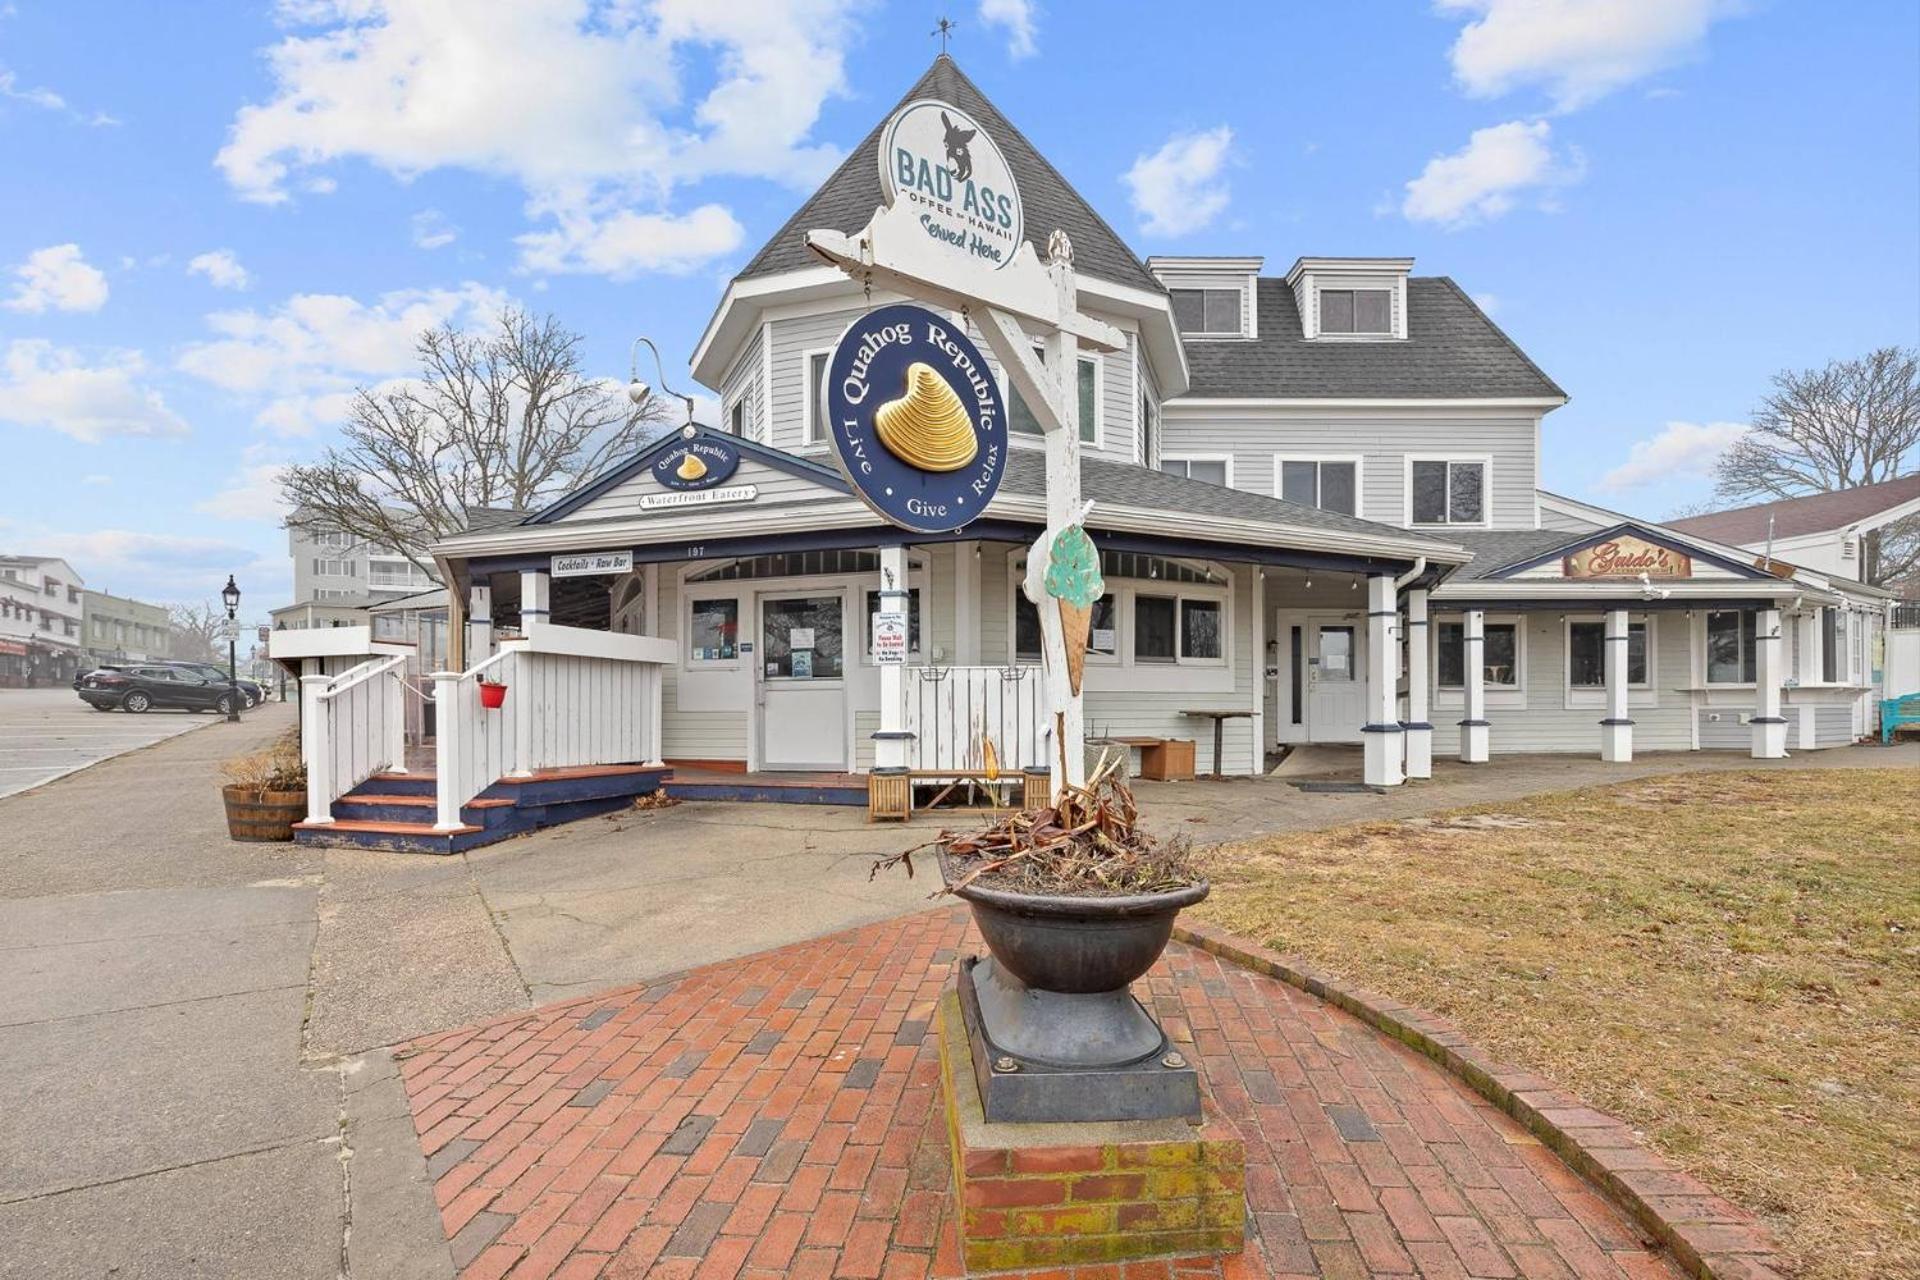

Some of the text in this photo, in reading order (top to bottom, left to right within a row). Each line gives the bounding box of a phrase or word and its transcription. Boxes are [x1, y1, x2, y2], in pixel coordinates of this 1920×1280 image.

[897, 147, 1012, 229] BAD ASS
[900, 188, 953, 217] OFFEE
[968, 217, 1012, 241] HAWAII
[919, 214, 1002, 263] Served Here
[843, 322, 996, 431] Quahog Republic
[658, 443, 729, 470] Quahog Republic
[843, 418, 999, 517] Live Give Relax
[647, 488, 750, 505] Waterfront Eatery
[557, 556, 627, 571] Cocktails Raw Bar
[687, 547, 704, 557] 197
[1588, 542, 1669, 573] Guido's
